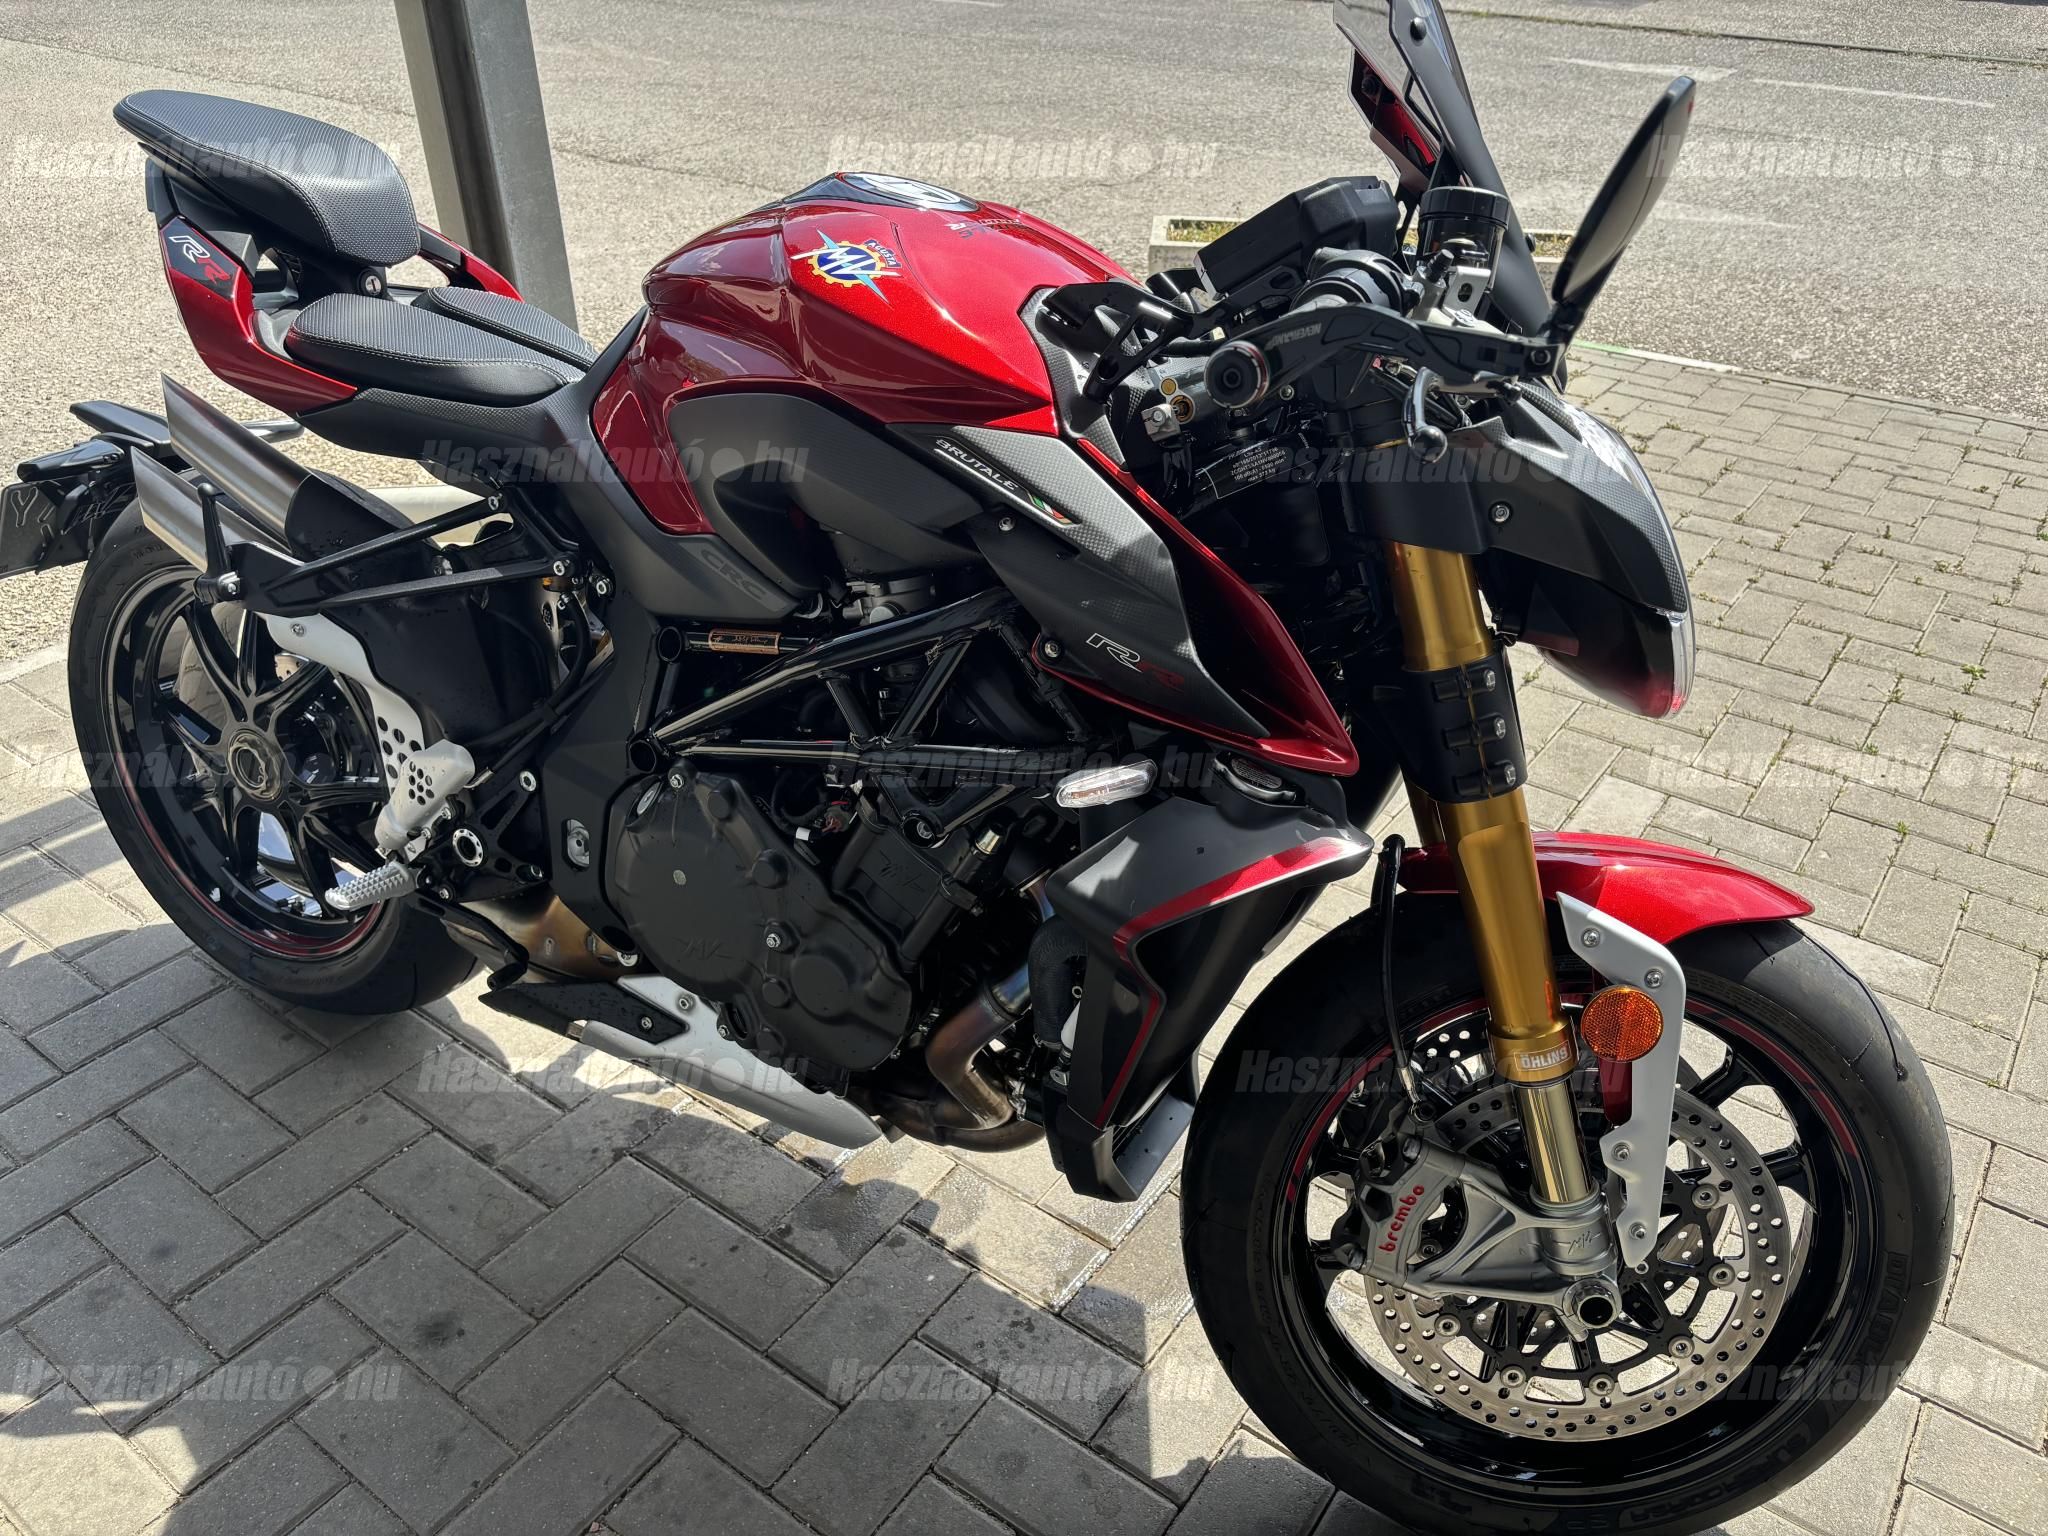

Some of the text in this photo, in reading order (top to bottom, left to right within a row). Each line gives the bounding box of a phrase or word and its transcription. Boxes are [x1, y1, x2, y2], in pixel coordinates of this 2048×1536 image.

[867, 241, 899, 267] AGUSTA
[935, 439, 1019, 491] BRUTALE
[701, 549, 767, 601] CRC
[1379, 1184, 1425, 1253] brembo
